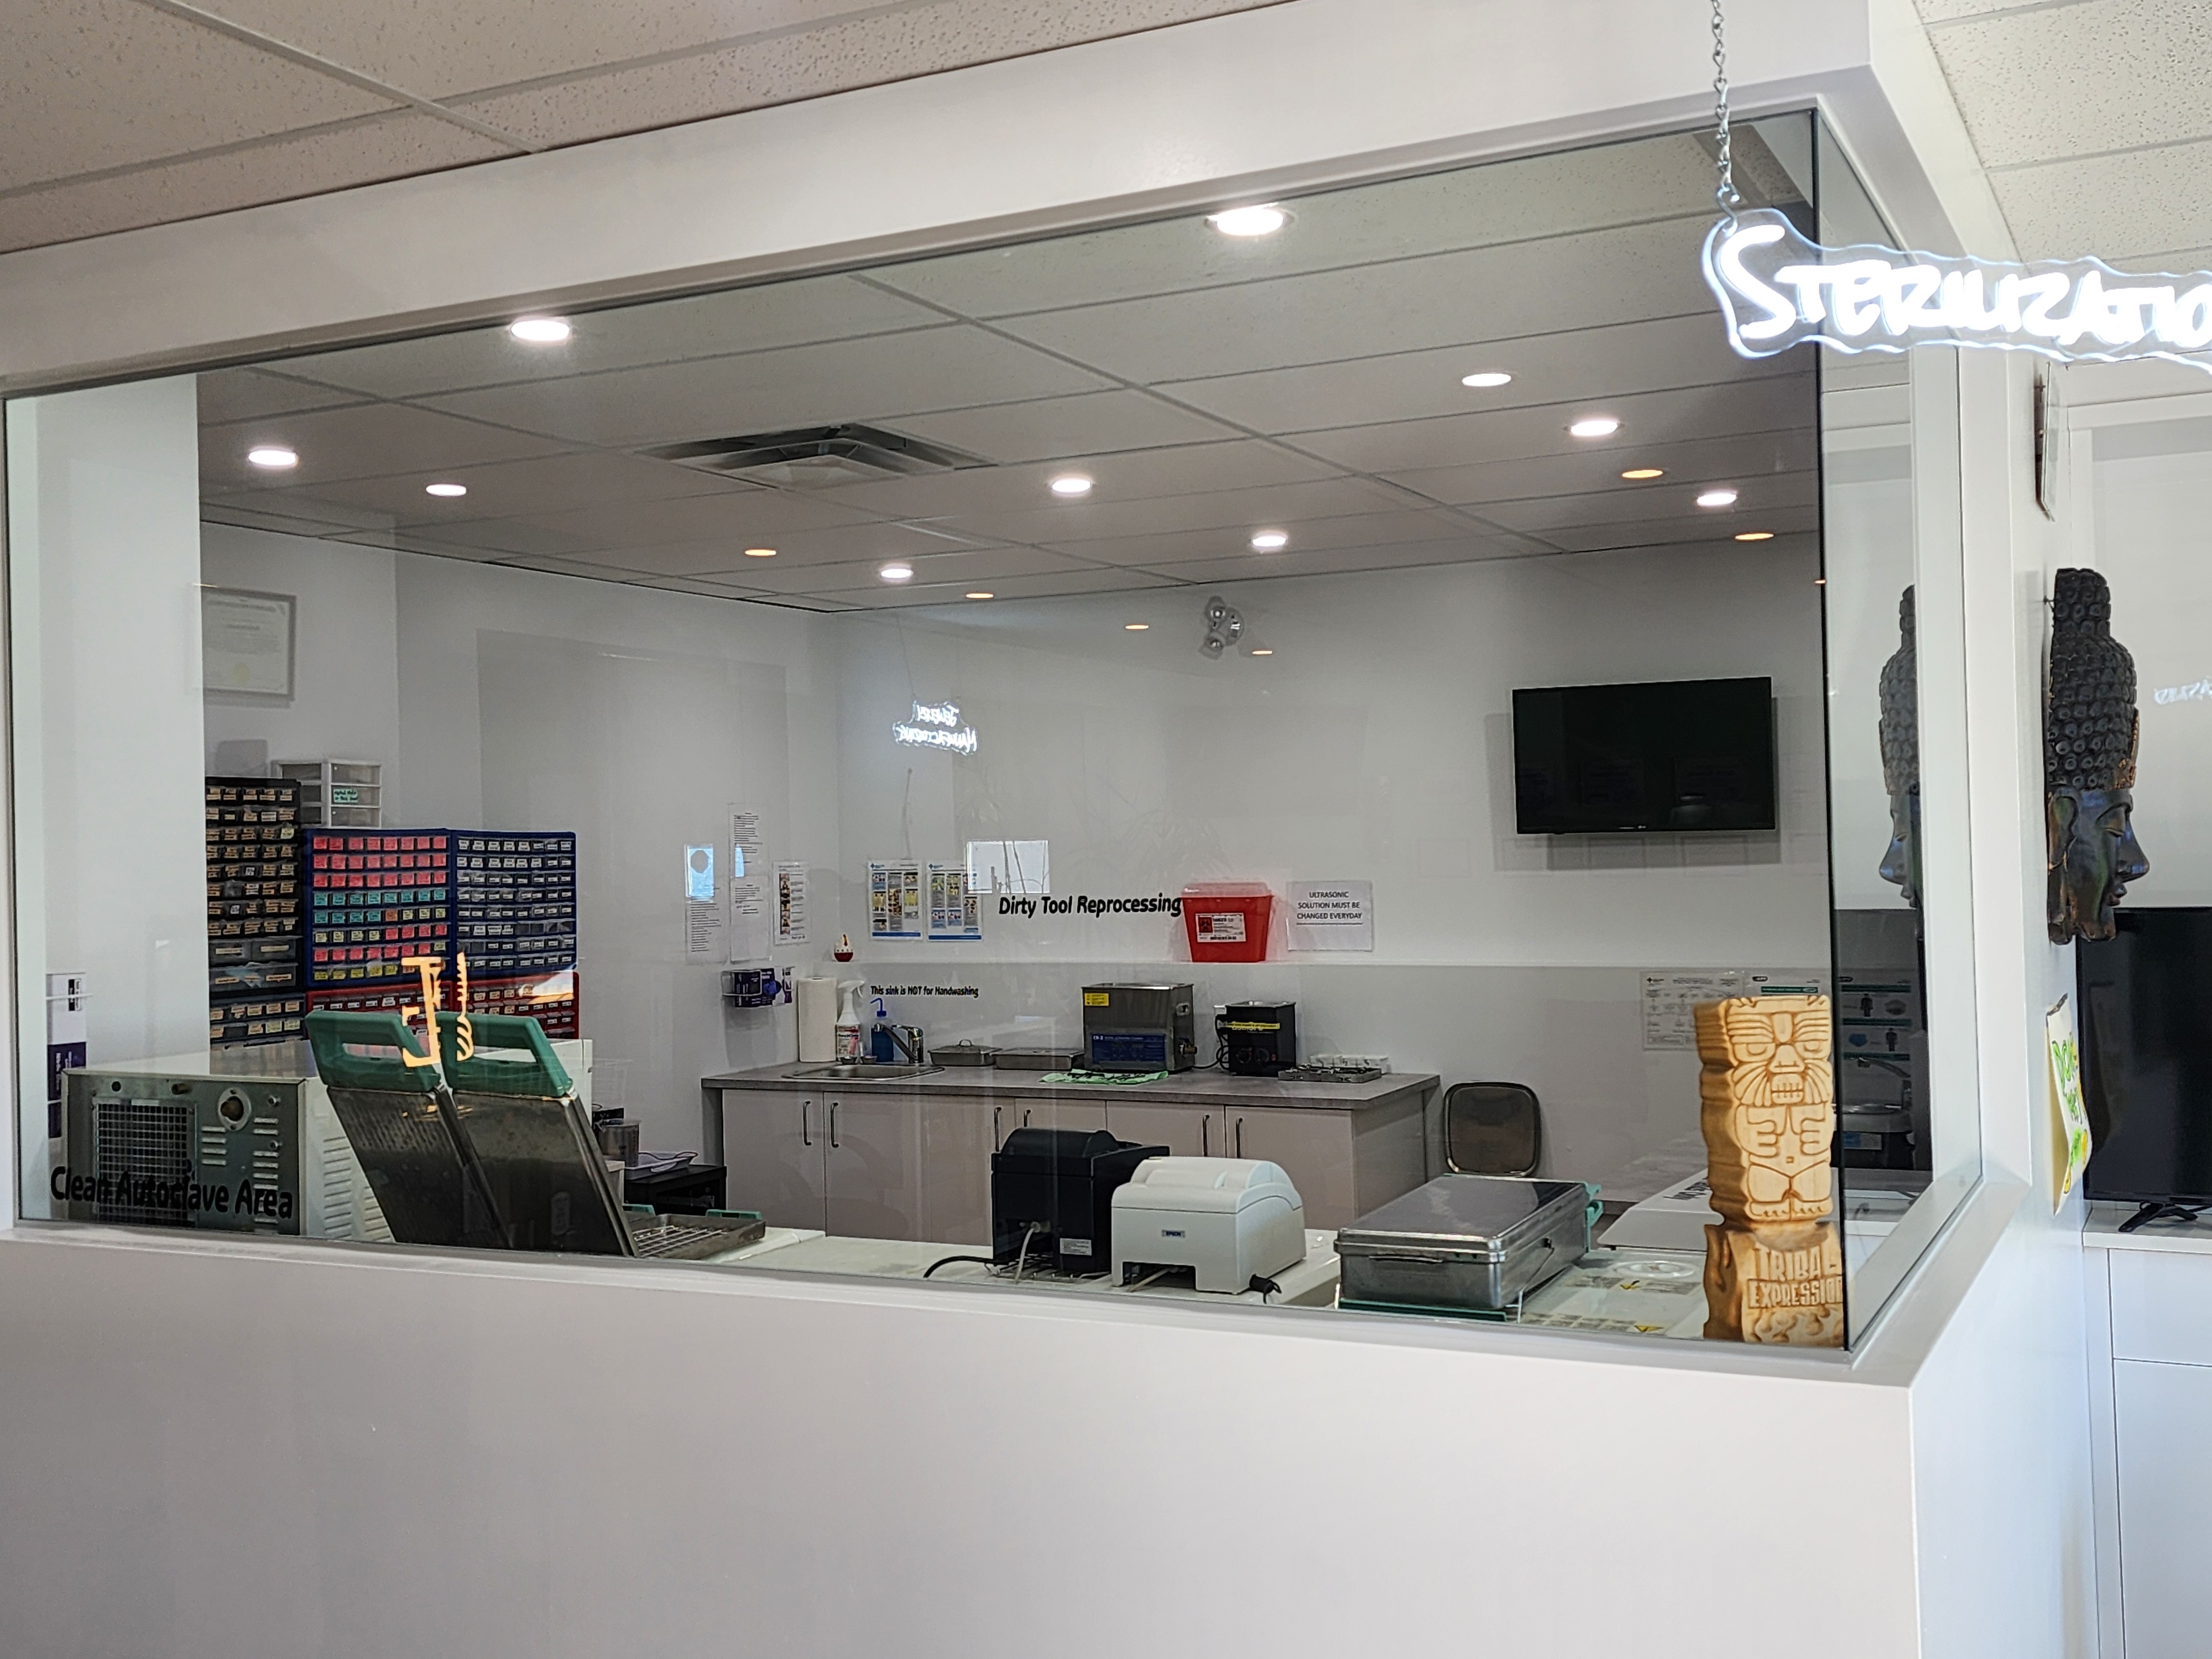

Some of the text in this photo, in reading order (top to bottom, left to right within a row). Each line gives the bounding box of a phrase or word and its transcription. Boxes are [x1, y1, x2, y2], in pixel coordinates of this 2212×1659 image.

[999, 892, 1181, 919] Dirty Tool Reprocessing
[870, 985, 979, 998] This sink is NOT for Handwashing
[50, 1166, 293, 1219] Clean Autoclave Area
[1752, 1244, 1842, 1282] TRIBAL
